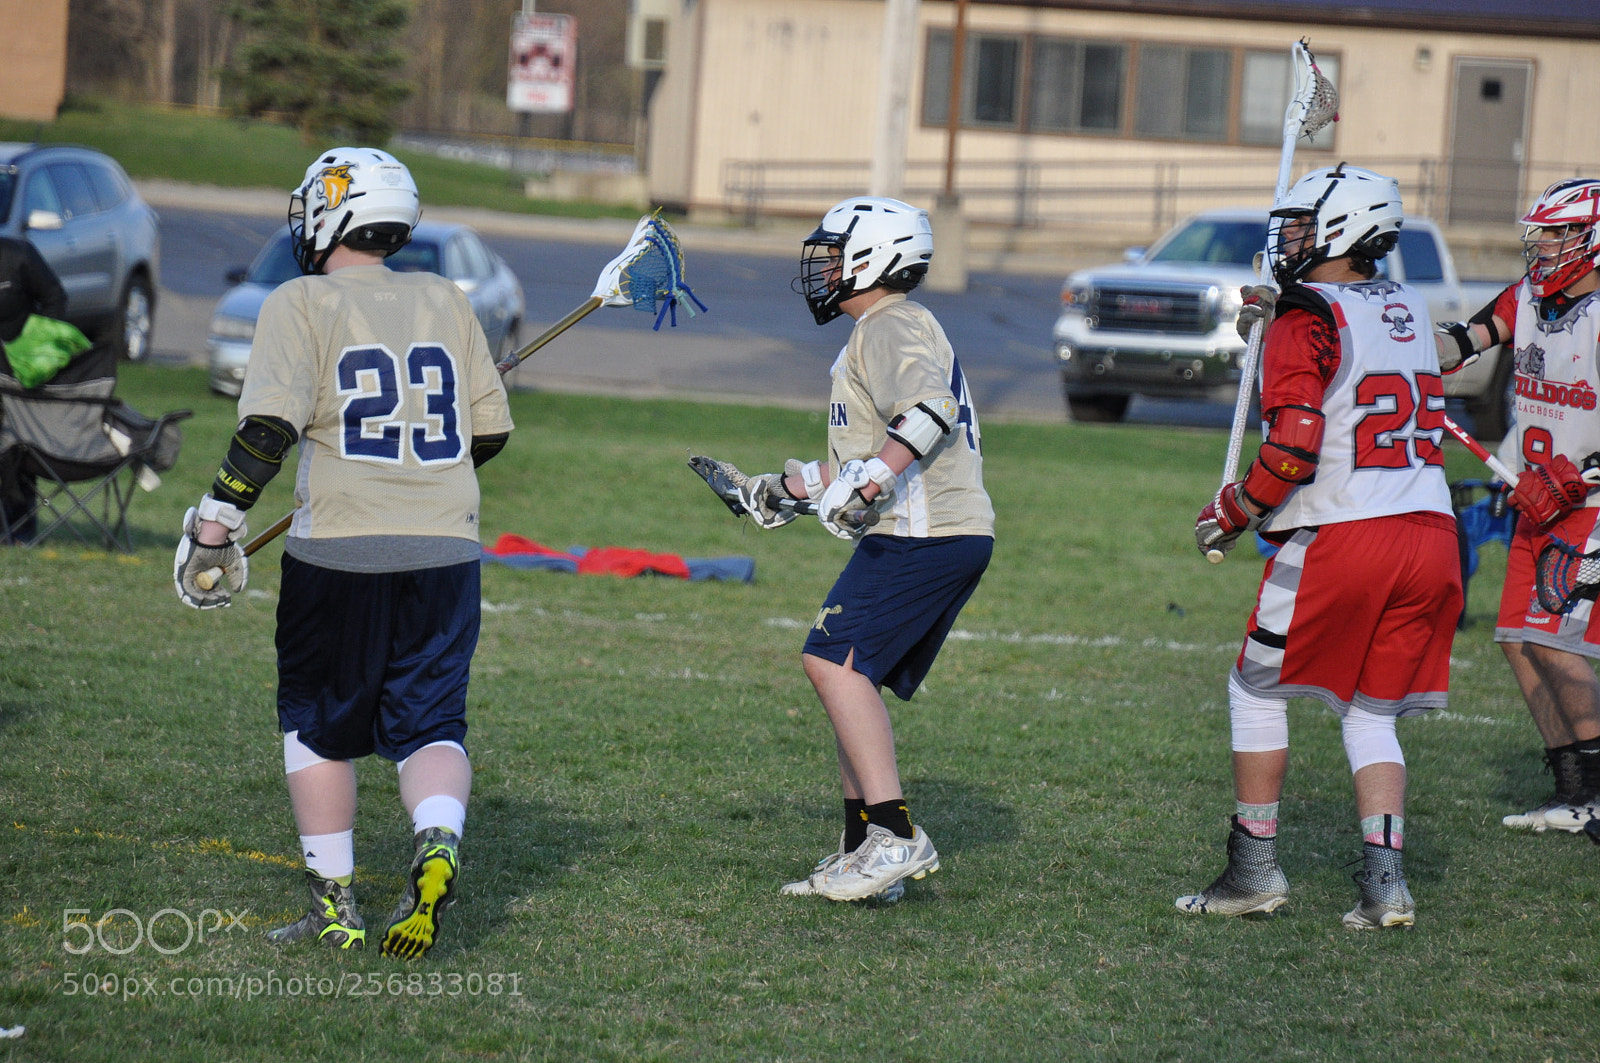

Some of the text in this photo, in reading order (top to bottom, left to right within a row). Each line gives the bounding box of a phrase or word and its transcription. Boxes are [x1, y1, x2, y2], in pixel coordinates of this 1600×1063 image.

[336, 342, 466, 466] 23
[1514, 374, 1598, 411] ULLDOGS
[1518, 401, 1565, 421] LACROSSE
[829, 401, 849, 427] AN
[1351, 369, 1446, 473] 25
[1537, 464, 1570, 508] ARRIOR
